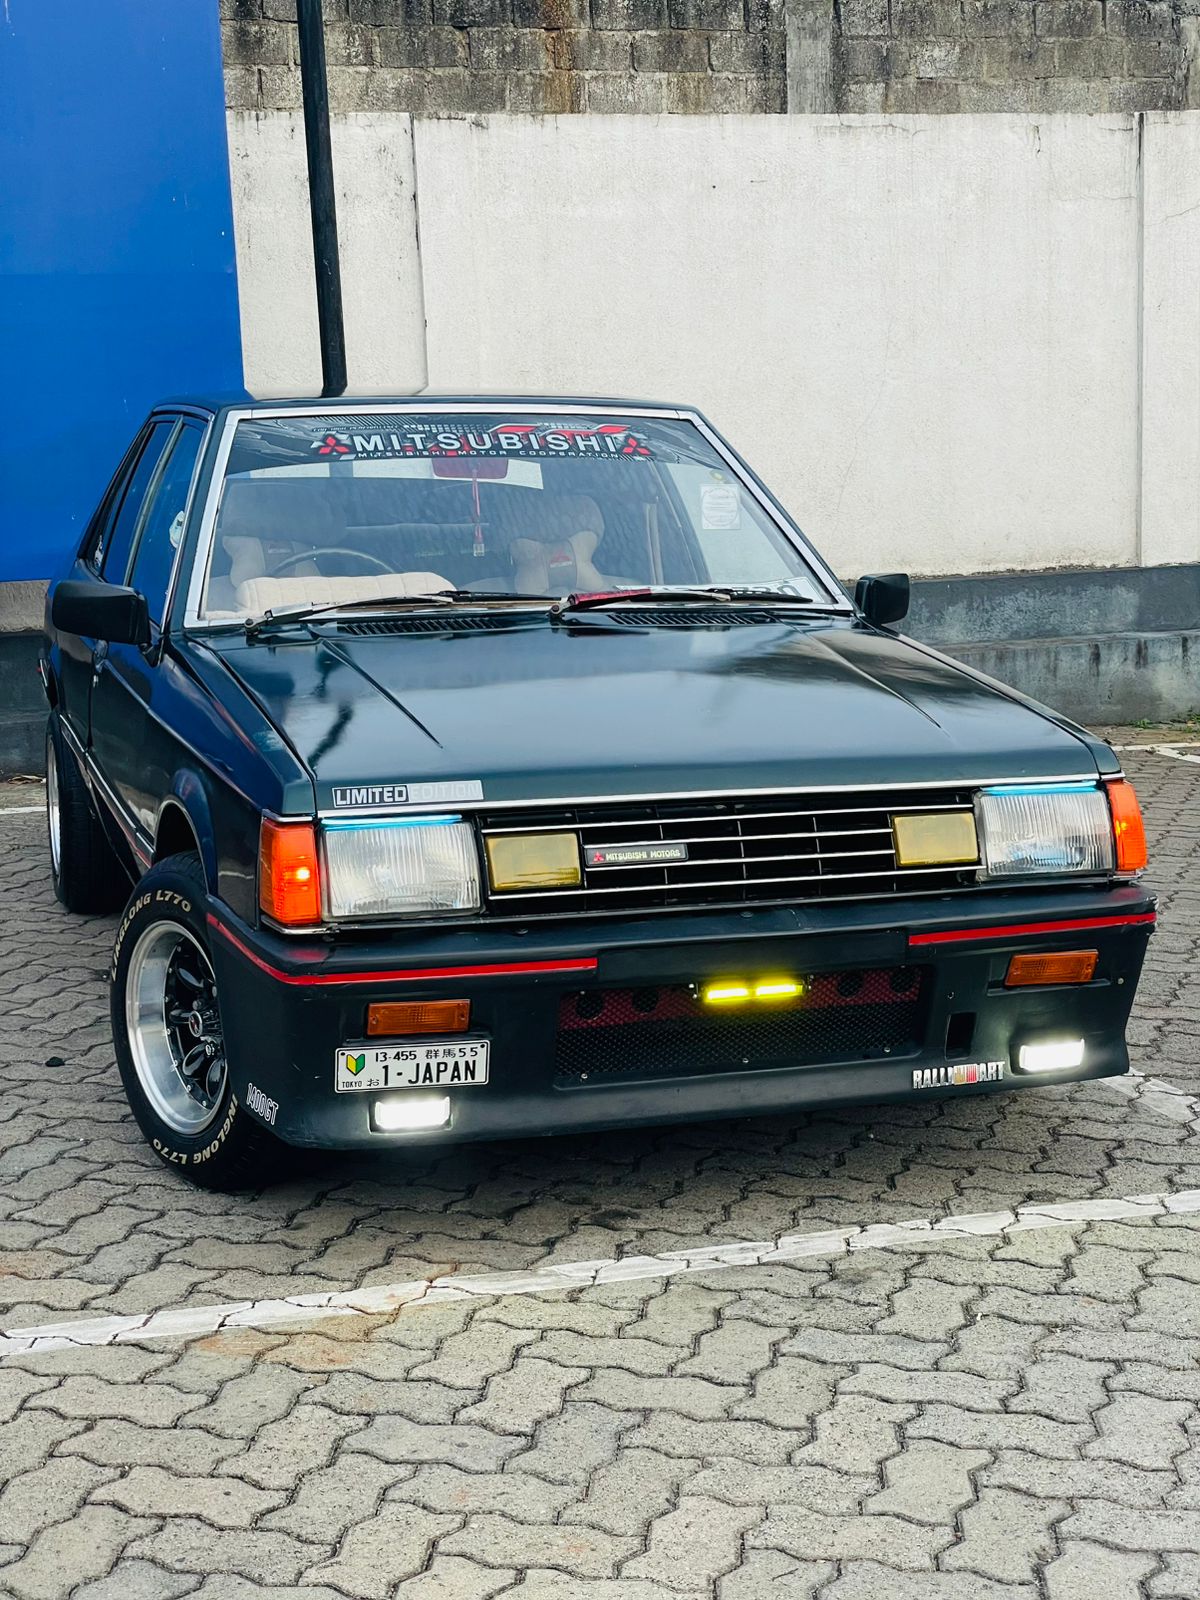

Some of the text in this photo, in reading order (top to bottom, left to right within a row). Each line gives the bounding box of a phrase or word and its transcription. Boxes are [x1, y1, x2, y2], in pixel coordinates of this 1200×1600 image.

[353, 432, 616, 452] MITSUBISHI
[358, 450, 446, 458] MITSUBISHI
[519, 450, 619, 459] COOPERATION
[336, 782, 480, 806] LIMITED EDITION
[605, 849, 681, 861] MITSUBISHI MOTORS
[112, 889, 191, 982] LINGLONG L770
[375, 1050, 417, 1063] 13-455
[341, 1080, 363, 1089] TOKYO
[153, 1093, 238, 1165] INGLONG L770
